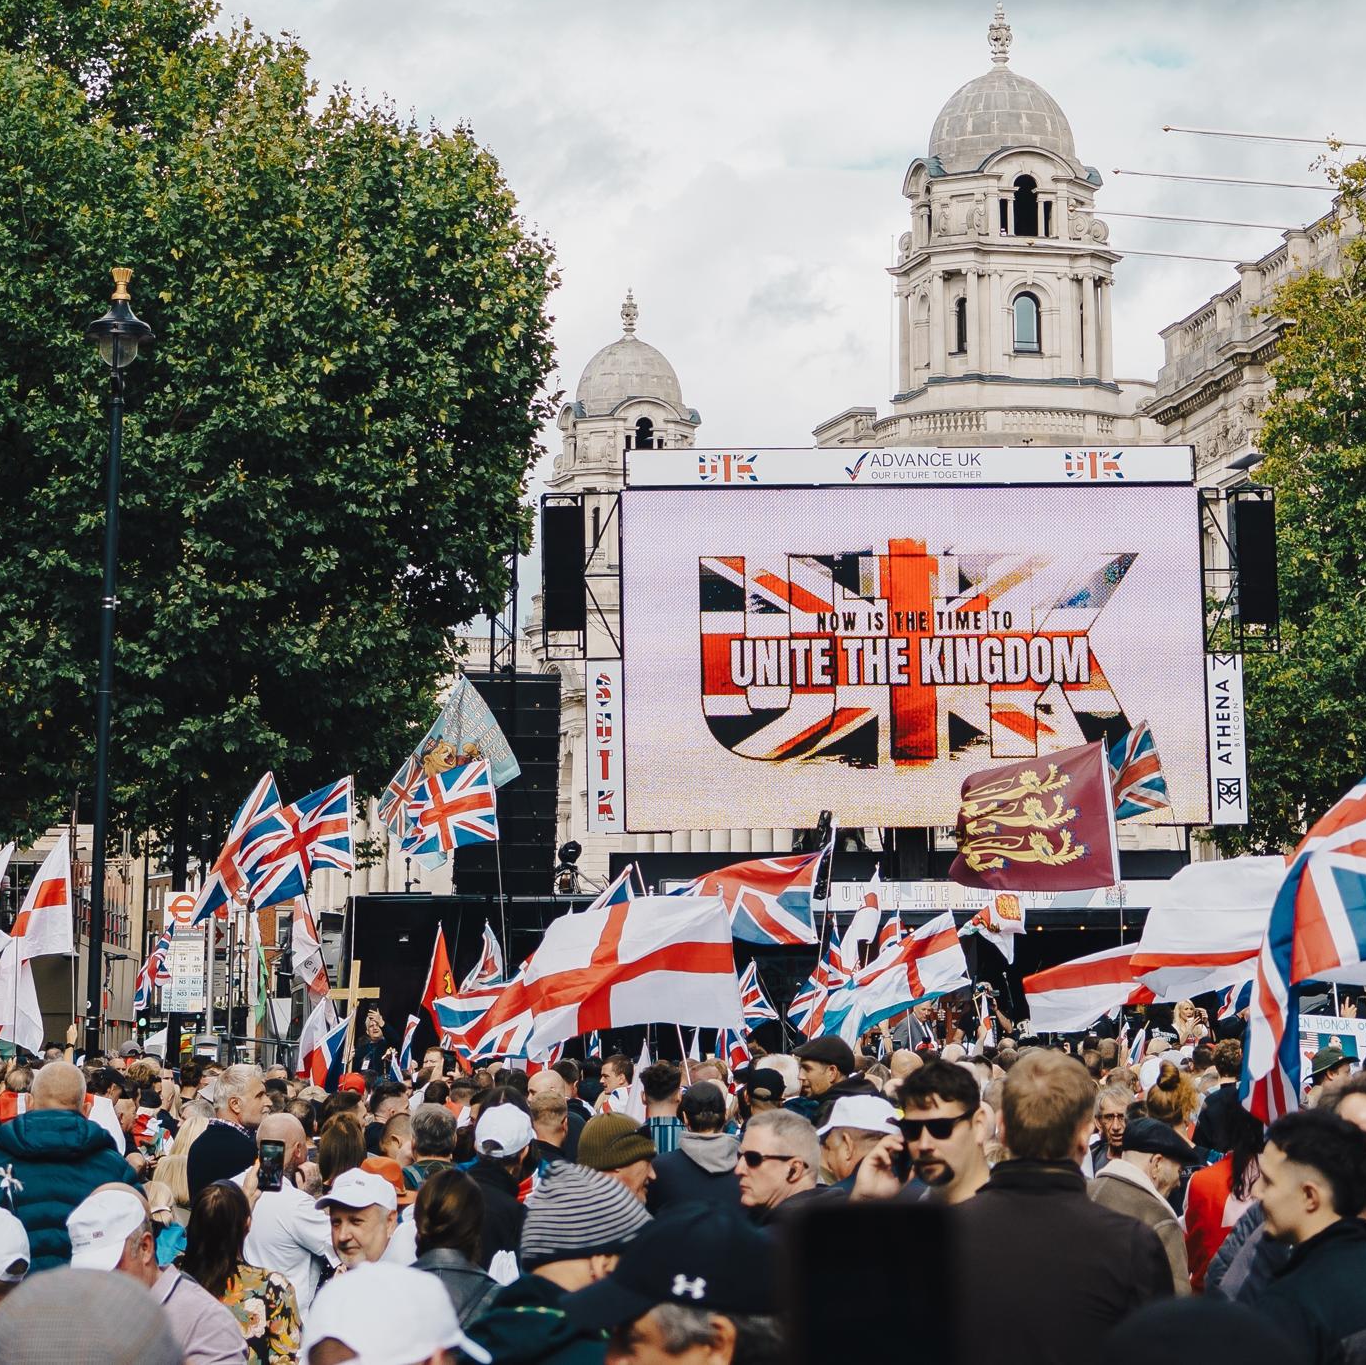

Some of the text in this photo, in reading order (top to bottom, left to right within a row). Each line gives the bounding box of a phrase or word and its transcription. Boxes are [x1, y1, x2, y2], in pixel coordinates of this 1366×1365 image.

[698, 454, 758, 482] UTK
[870, 452, 982, 467] ADVANCE UK
[1065, 451, 1125, 479] UTK
[871, 470, 982, 479] OUR FUTURE TOGETHER
[817, 610, 1013, 631] NOW IS THE TIME TO
[730, 635, 1091, 687] UNITE THE KINGDOM
[1215, 679, 1233, 765] ATHENA
[842, 886, 902, 901] UNTE
[915, 886, 950, 901] THE
[1316, 1018, 1351, 1031] HONOR
